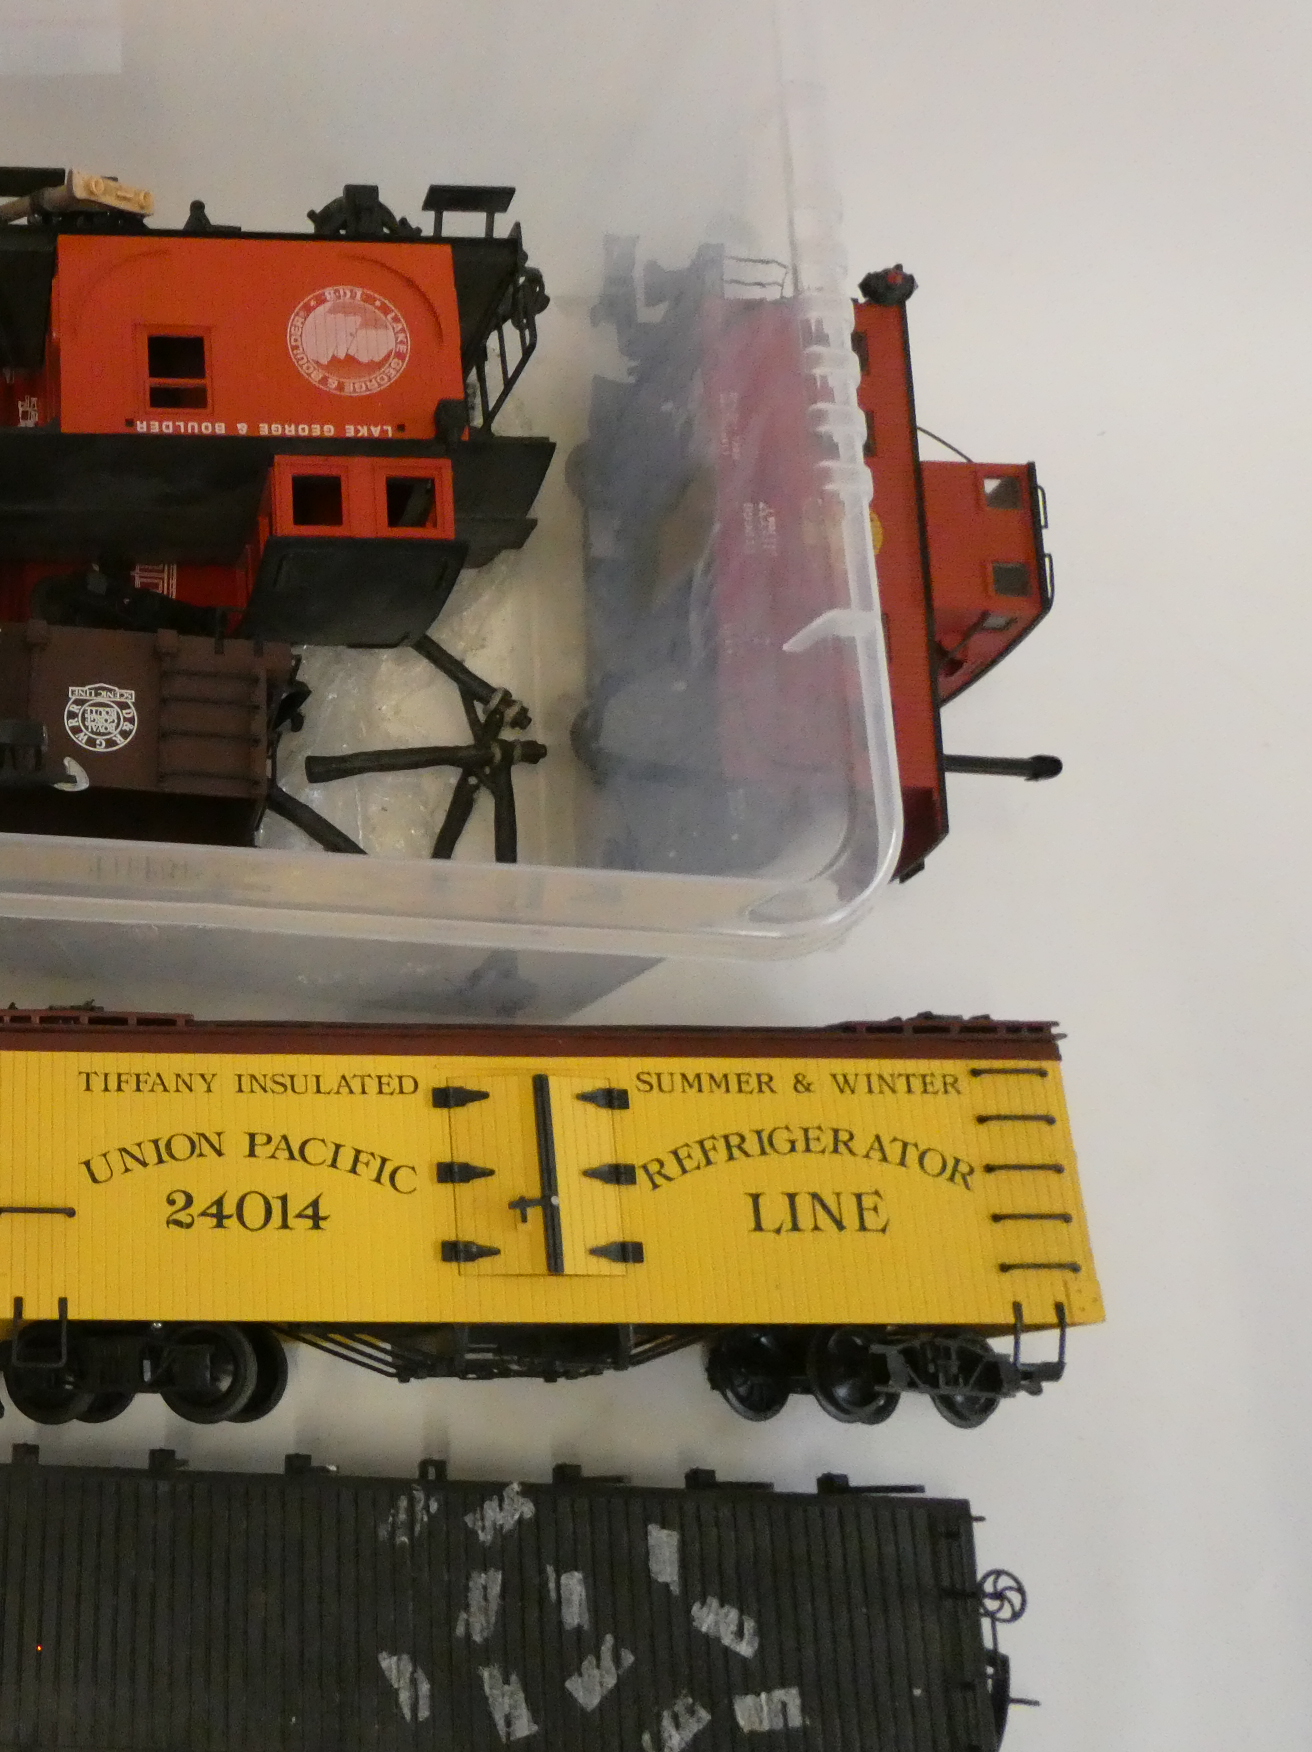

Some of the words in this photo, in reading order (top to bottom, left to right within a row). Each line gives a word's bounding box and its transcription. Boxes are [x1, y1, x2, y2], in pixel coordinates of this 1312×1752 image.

[136, 420, 226, 434] BOULDER
[236, 423, 248, 434] &
[258, 423, 335, 436] GEORGE
[344, 424, 393, 438] LAKE
[72, 688, 95, 698] LINE
[97, 689, 133, 700] SCENIC
[87, 724, 116, 734] ROYAL
[78, 1070, 218, 1094] TIFFANY
[234, 1073, 420, 1097] INSULATED
[635, 1070, 779, 1095] SUMMER
[793, 1072, 815, 1095] &
[829, 1072, 963, 1096] WINTER
[78, 1130, 227, 1185] UNION
[242, 1130, 418, 1195] PACIFIC
[638, 1124, 976, 1193] REFRIGERATOR
[164, 1188, 331, 1232] 24014
[744, 1188, 890, 1236] LINE
